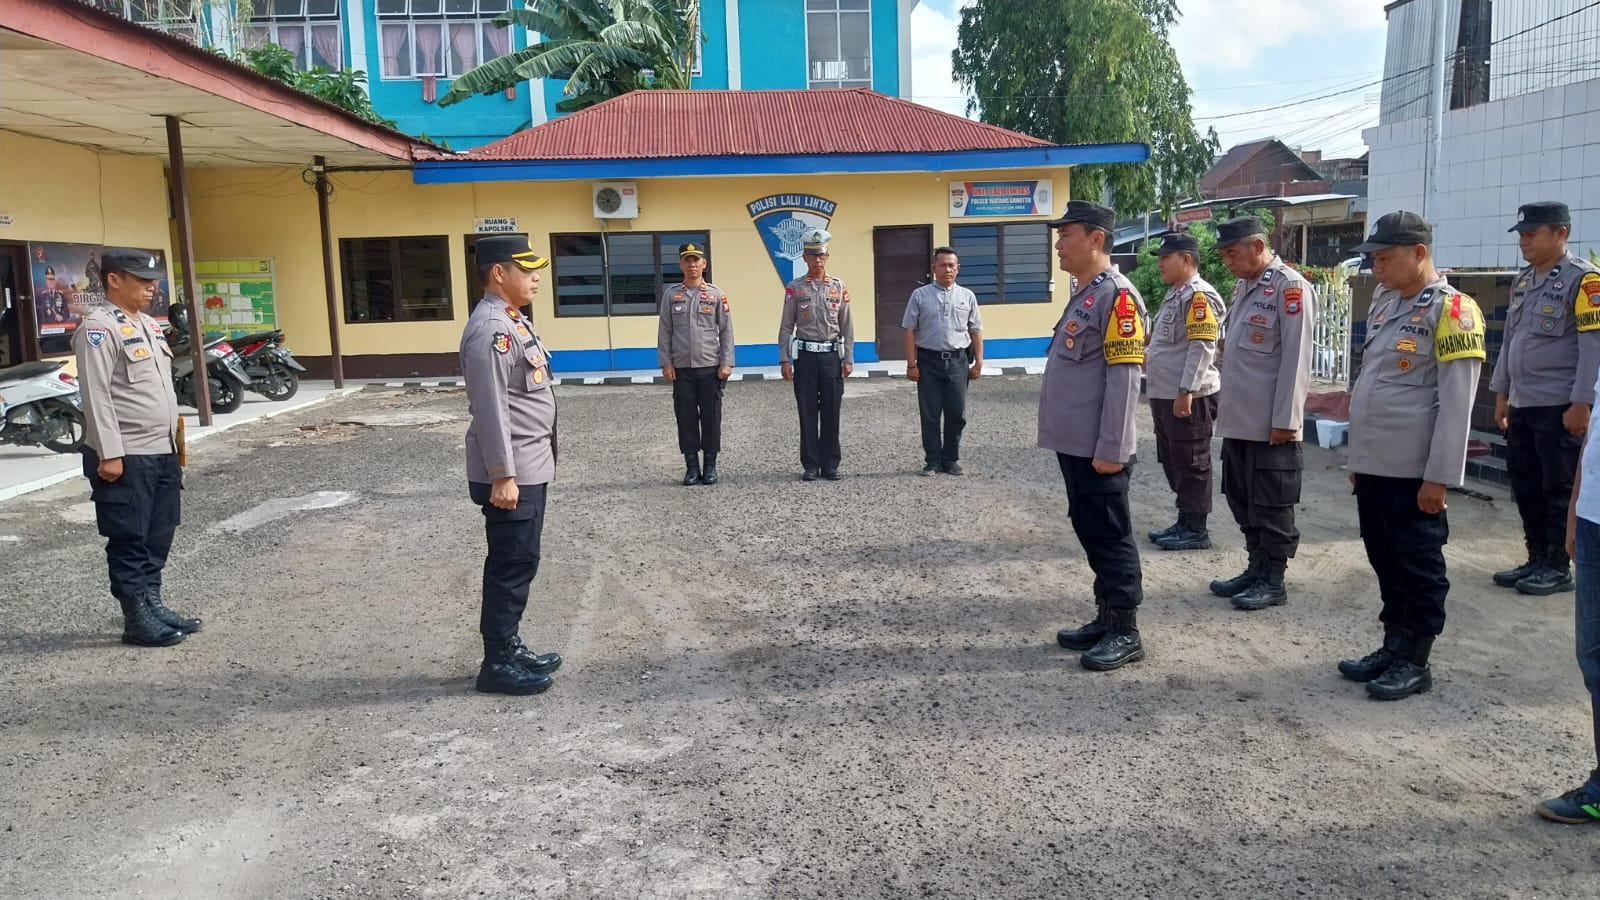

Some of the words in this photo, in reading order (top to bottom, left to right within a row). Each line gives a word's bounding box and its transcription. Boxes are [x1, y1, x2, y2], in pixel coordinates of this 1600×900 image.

[750, 196, 777, 214] POLISI
[780, 194, 800, 206] LALU
[804, 196, 835, 213] LINTAS
[72, 291, 105, 305] DIRGA
[1252, 300, 1277, 312] POLRI
[1073, 308, 1091, 322] POLRI
[1400, 325, 1429, 337] POLRI
